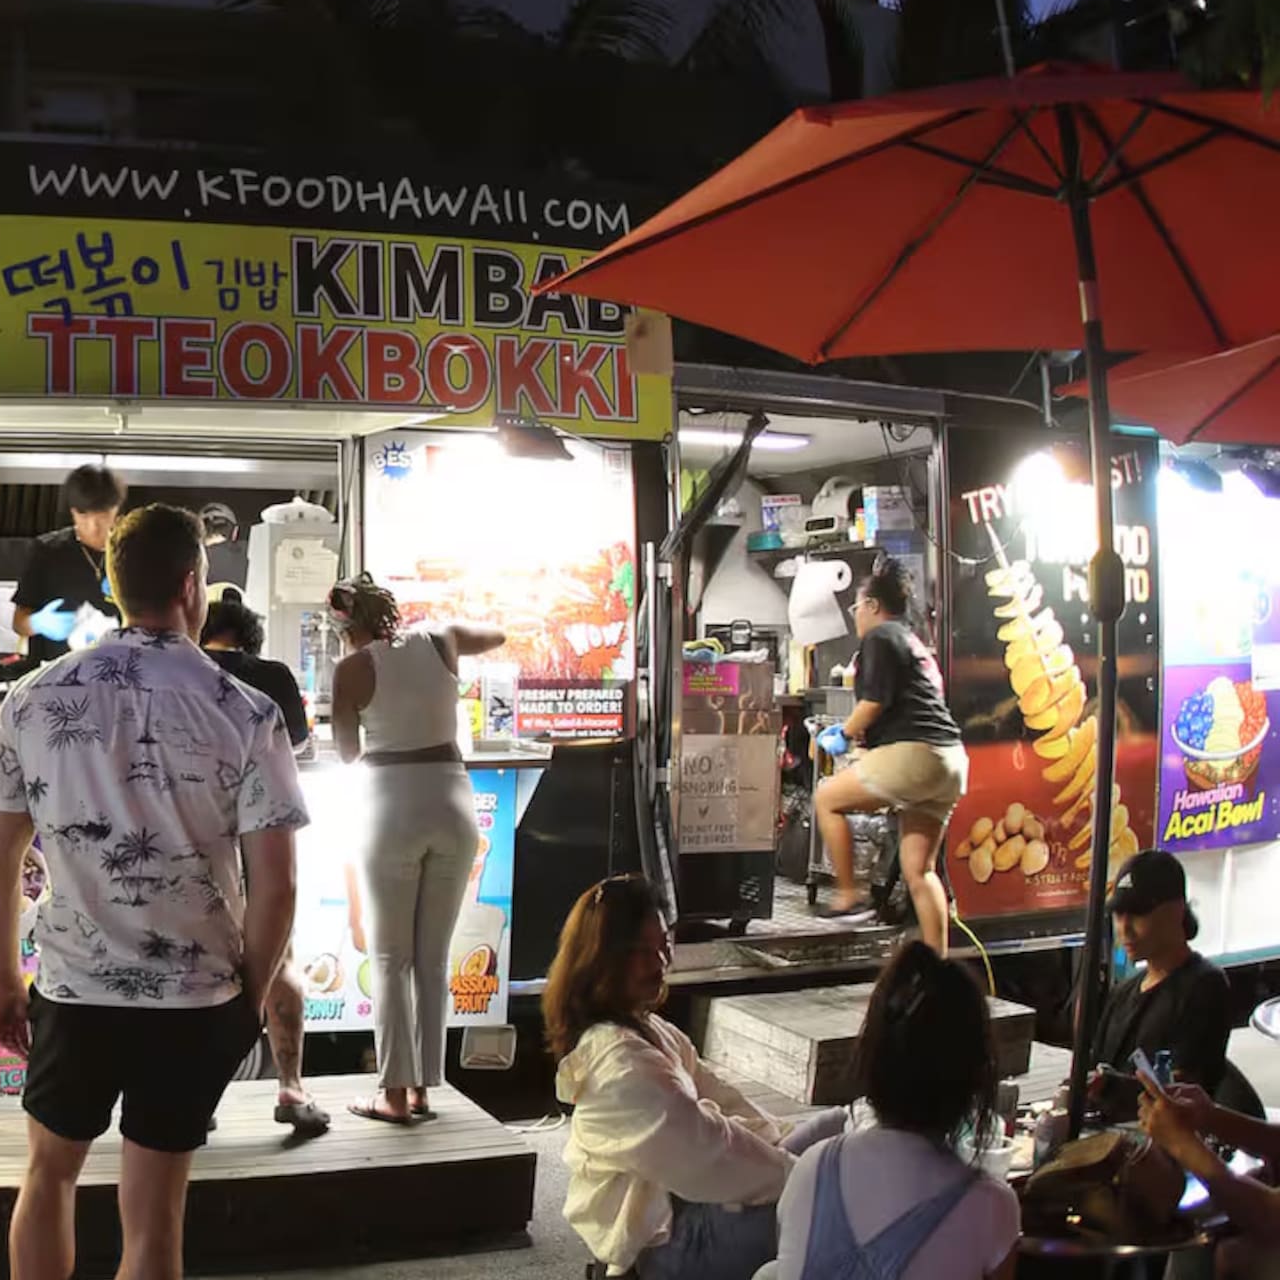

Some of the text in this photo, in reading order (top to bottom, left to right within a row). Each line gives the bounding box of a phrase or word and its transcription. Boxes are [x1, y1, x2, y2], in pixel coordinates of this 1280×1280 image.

[1, 231, 190, 326] 떡볶이
[205, 258, 288, 312] 김밥
[27, 314, 638, 422] TTEOKBOKKI
[372, 450, 413, 470] BES
[961, 482, 1011, 524] TRY
[564, 621, 625, 657] WOW
[519, 701, 623, 713] MADE TO ORDER!
[567, 689, 623, 701] PREPARED
[684, 756, 712, 776] NO
[681, 780, 736, 794] SMOKING
[1174, 782, 1243, 811] Hawaiian
[1163, 791, 1265, 841] Acai Bowl
[304, 998, 346, 1021] ONUT
[455, 993, 491, 1014] FRUIT
